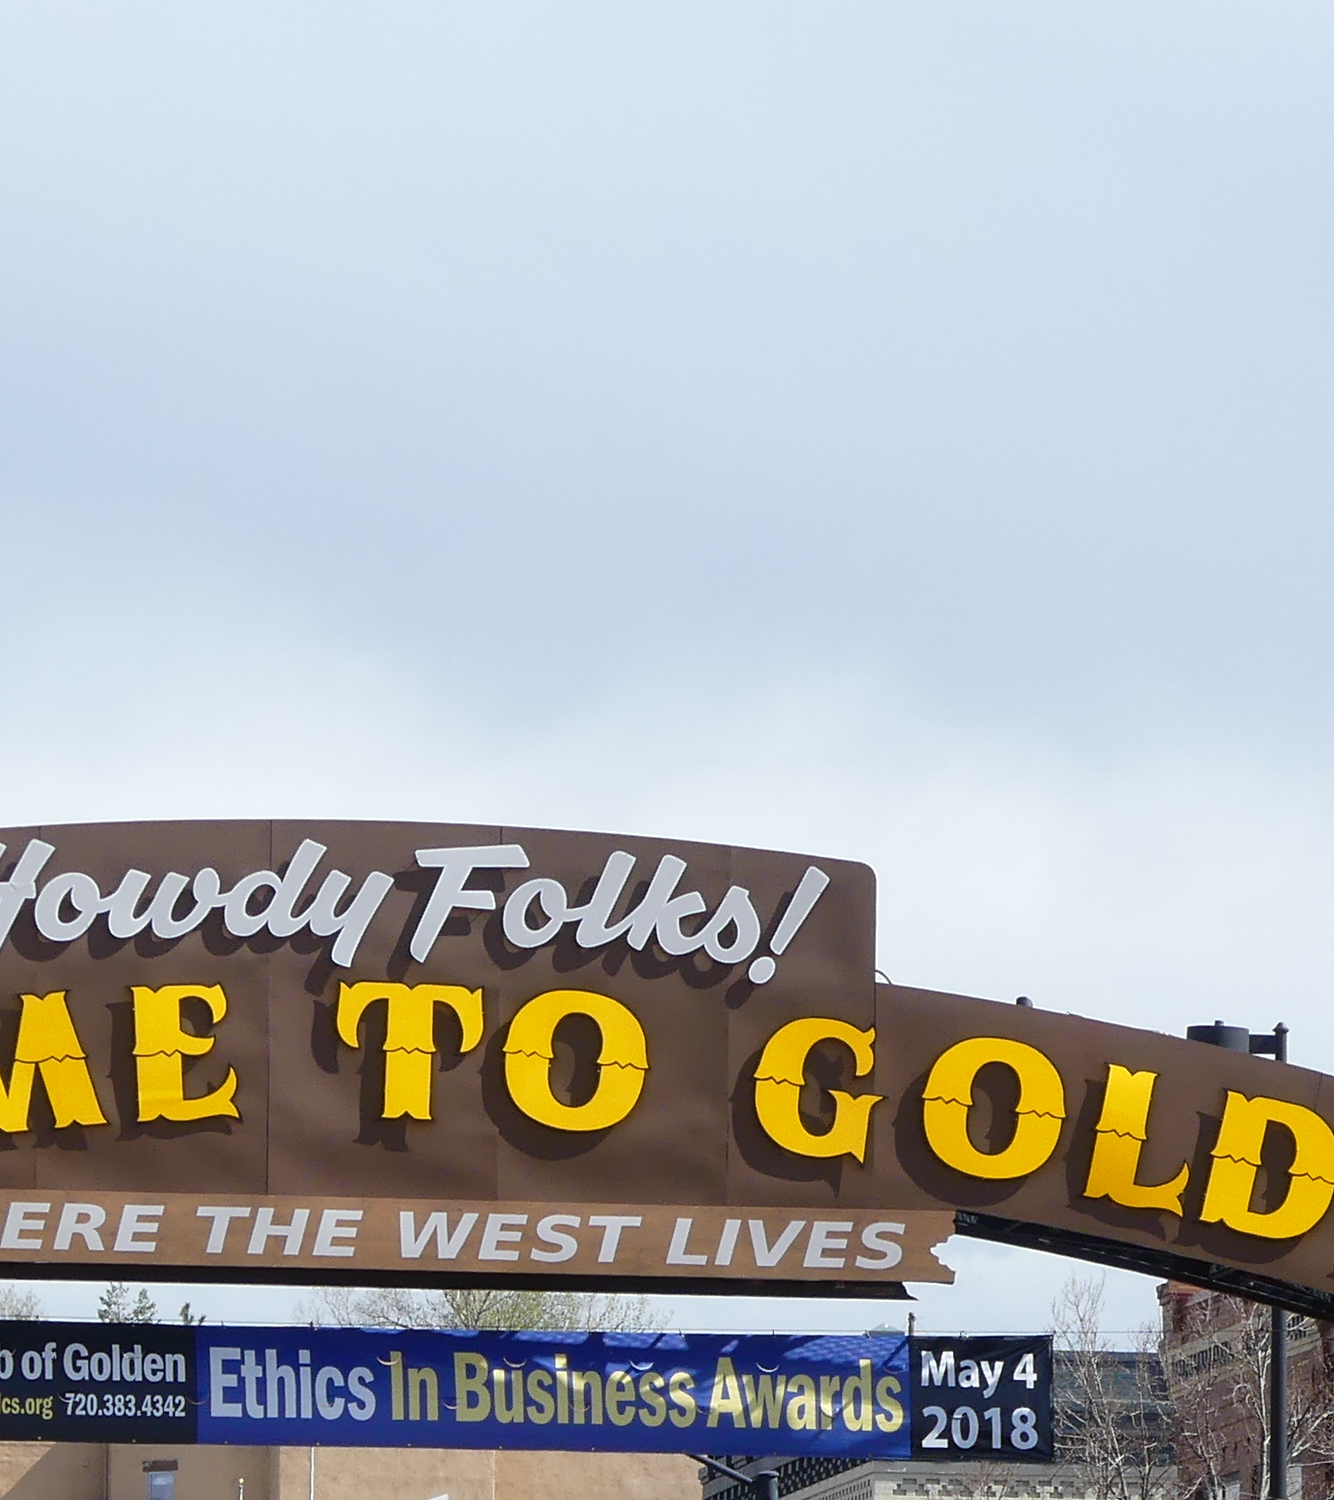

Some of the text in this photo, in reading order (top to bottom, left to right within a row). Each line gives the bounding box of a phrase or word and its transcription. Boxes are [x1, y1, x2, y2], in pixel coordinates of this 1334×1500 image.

[408, 843, 830, 985] Folks!
[336, 980, 649, 1132] TO
[196, 1204, 364, 1258] THE
[399, 1211, 643, 1264] WEST
[666, 1217, 906, 1271] LIVES
[21, 1343, 57, 1380] of
[63, 1344, 186, 1383] Golden
[209, 1346, 903, 1432] Ethics In Business Awards
[920, 1349, 1038, 1399] May 4
[64, 1393, 186, 1418] 720.383.4342
[922, 1406, 1039, 1451] 2018
